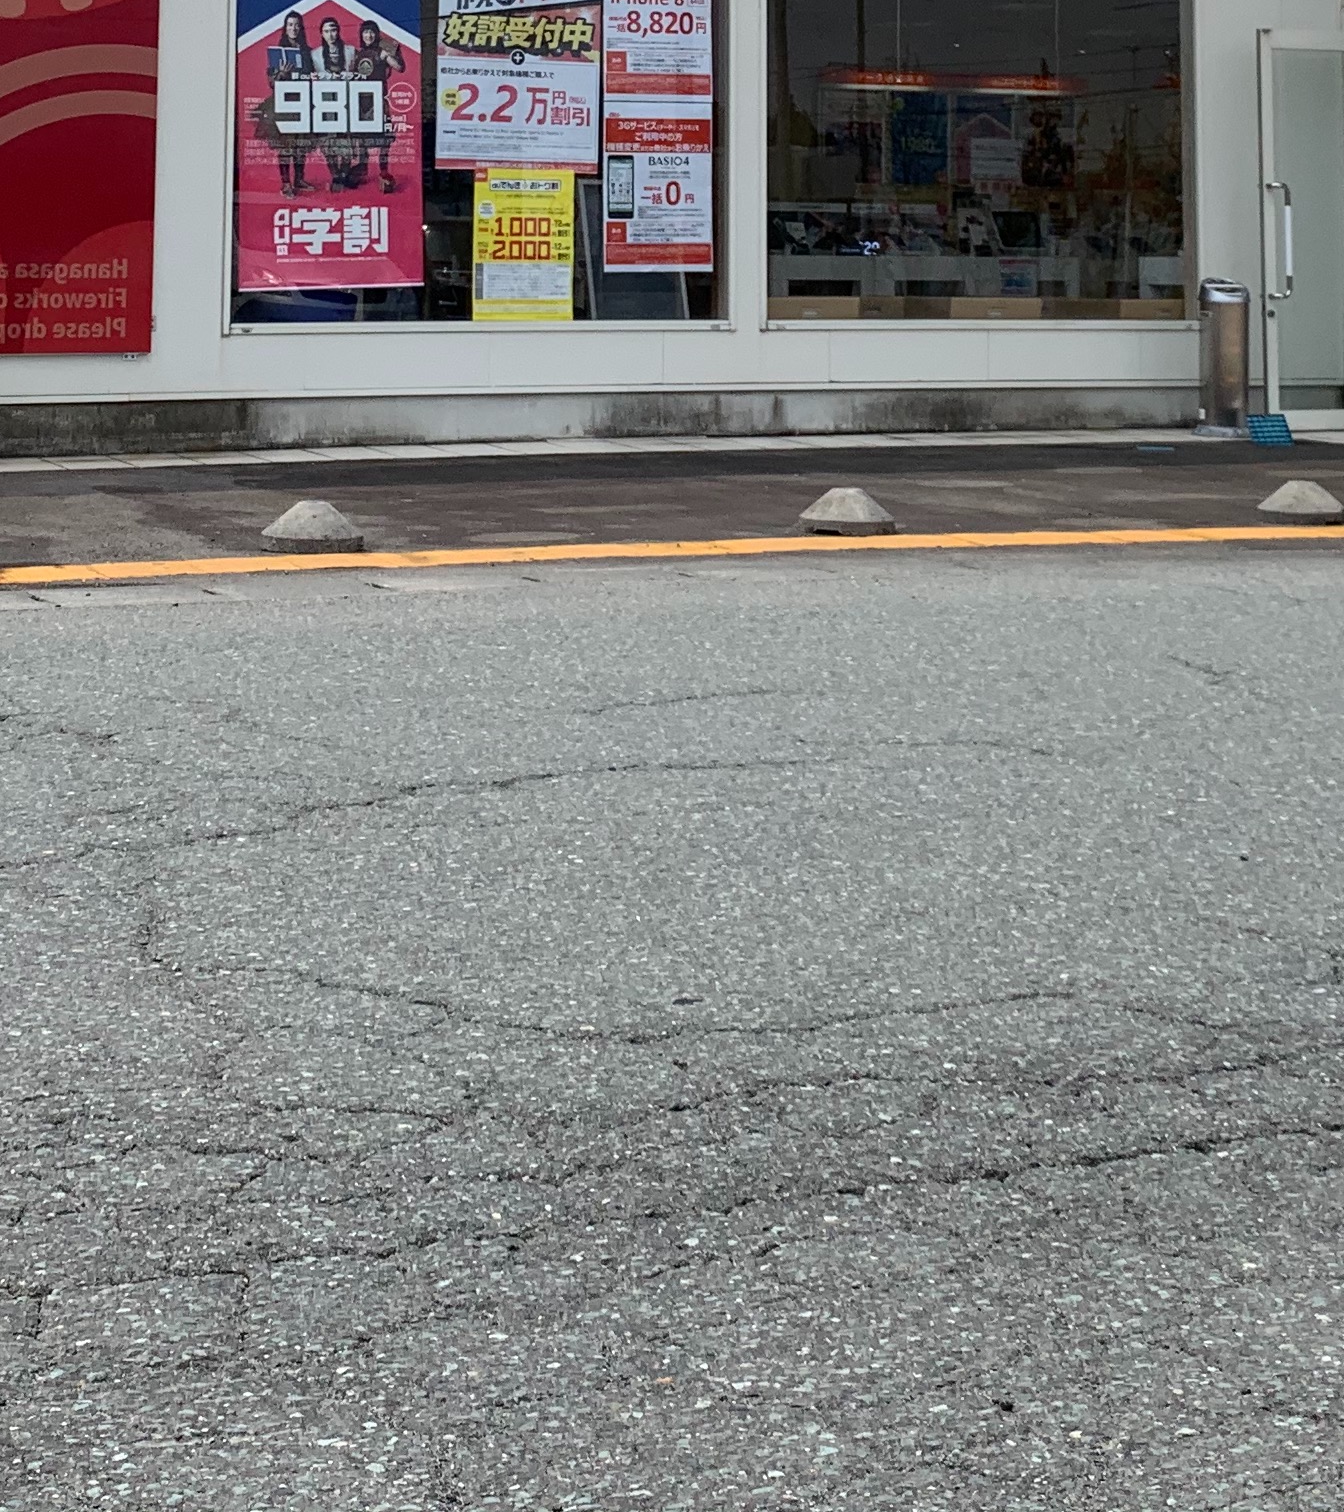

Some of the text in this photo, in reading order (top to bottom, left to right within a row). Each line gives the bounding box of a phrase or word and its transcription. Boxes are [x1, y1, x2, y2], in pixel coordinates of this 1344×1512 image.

[443, 13, 595, 51] 好評受付中
[274, 80, 384, 134] 980
